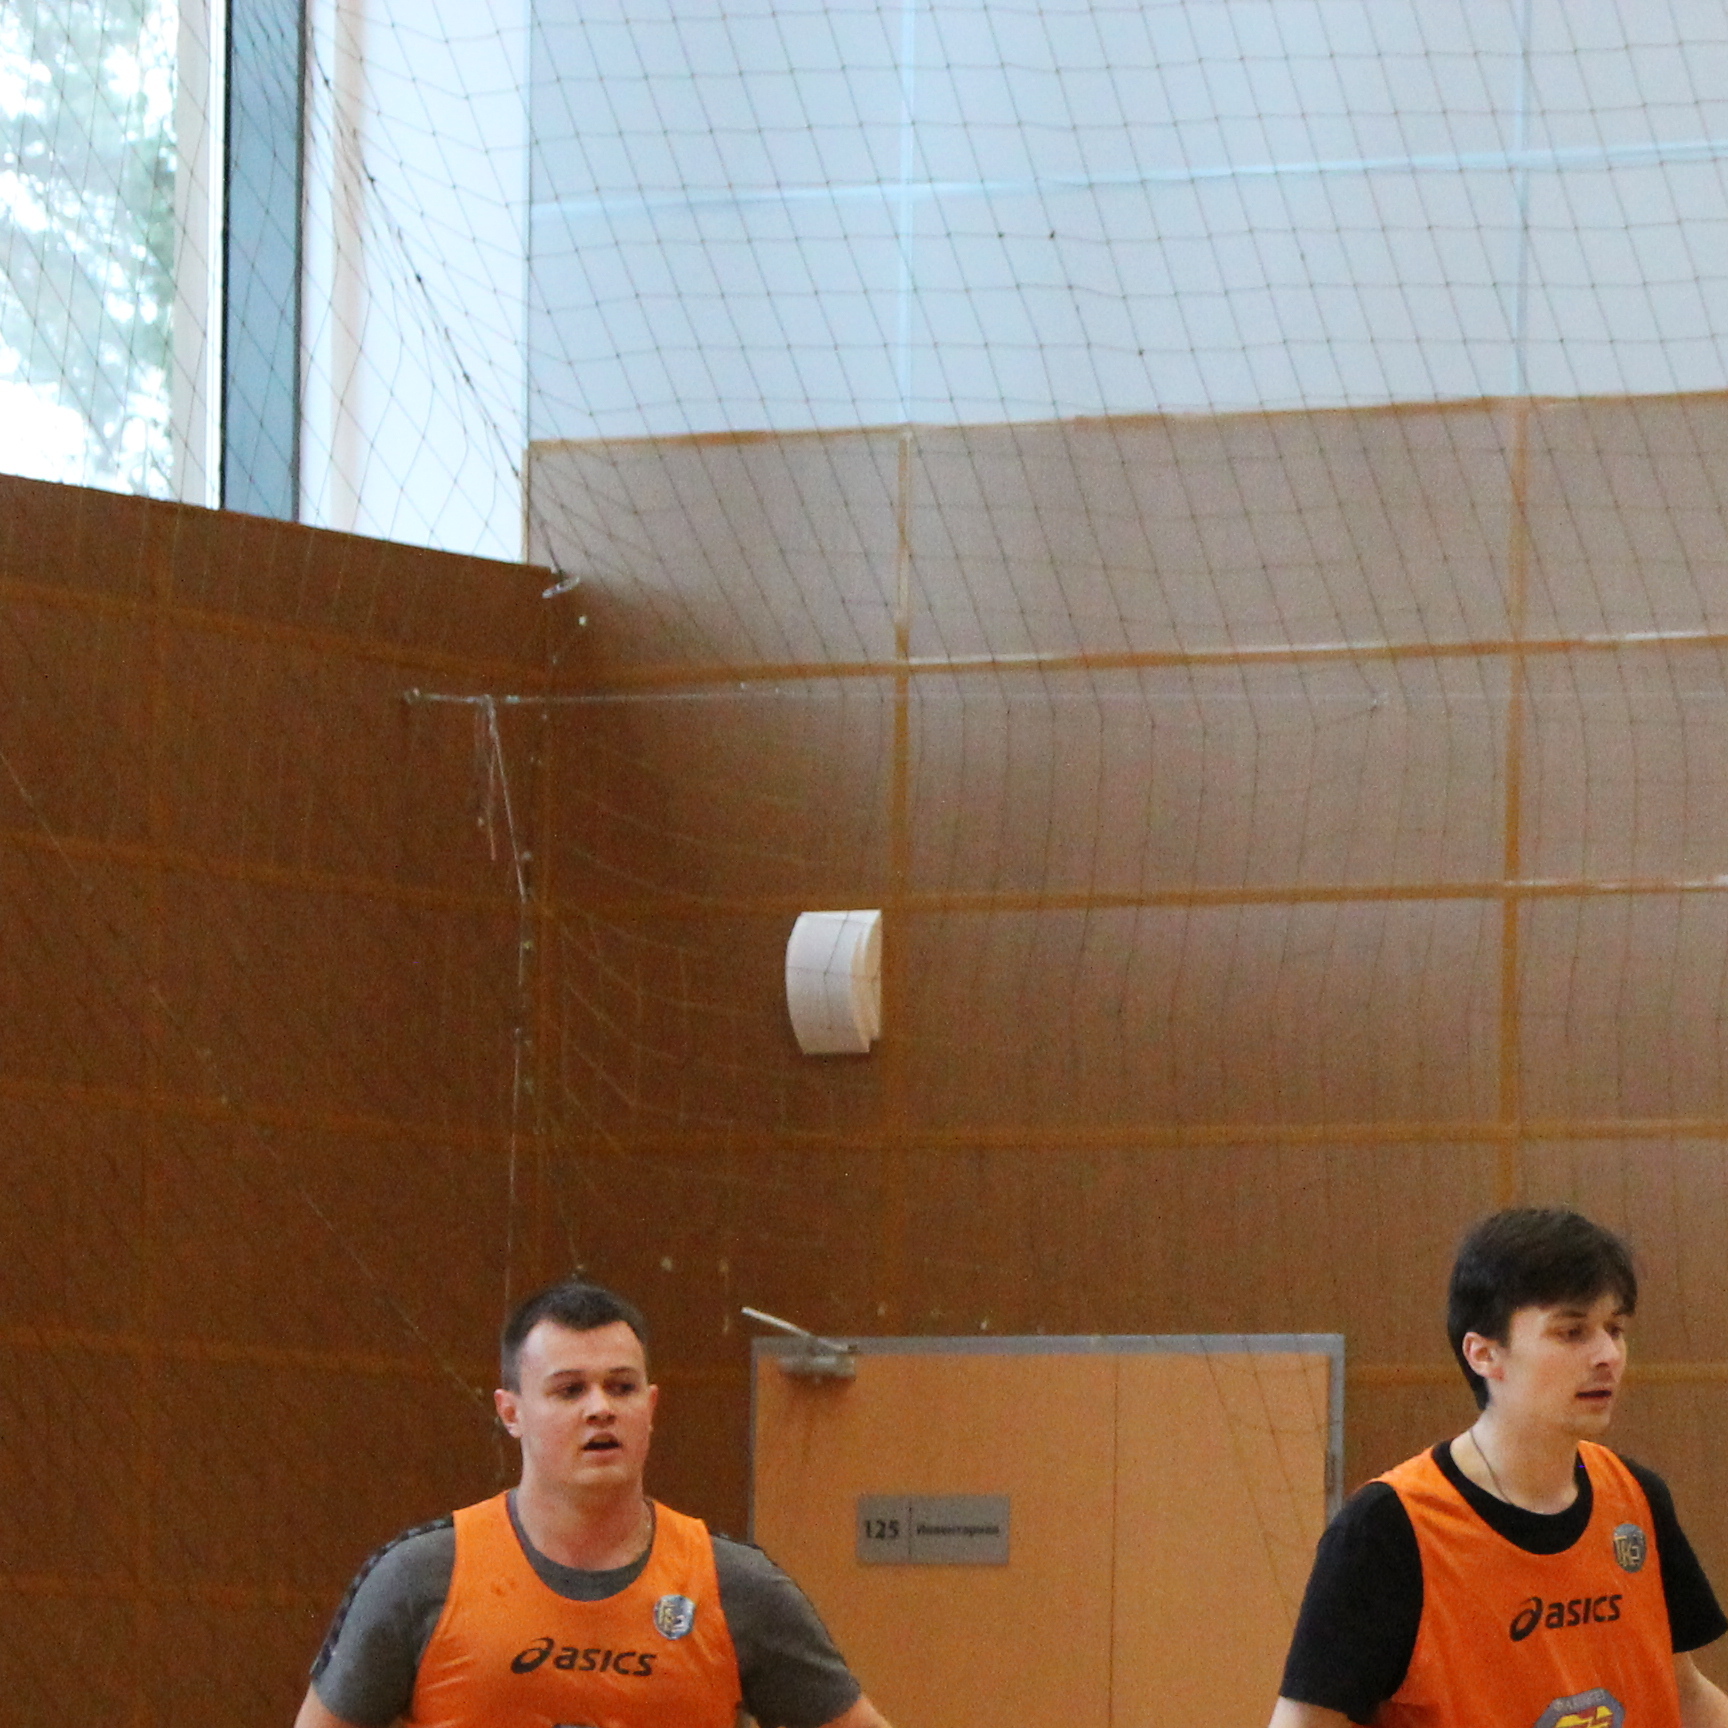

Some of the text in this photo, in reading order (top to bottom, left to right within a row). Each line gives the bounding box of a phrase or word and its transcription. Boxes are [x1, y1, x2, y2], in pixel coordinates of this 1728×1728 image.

[865, 1519, 900, 1540] 125
[1545, 1594, 1623, 1629] asics
[553, 1646, 657, 1677] asics
